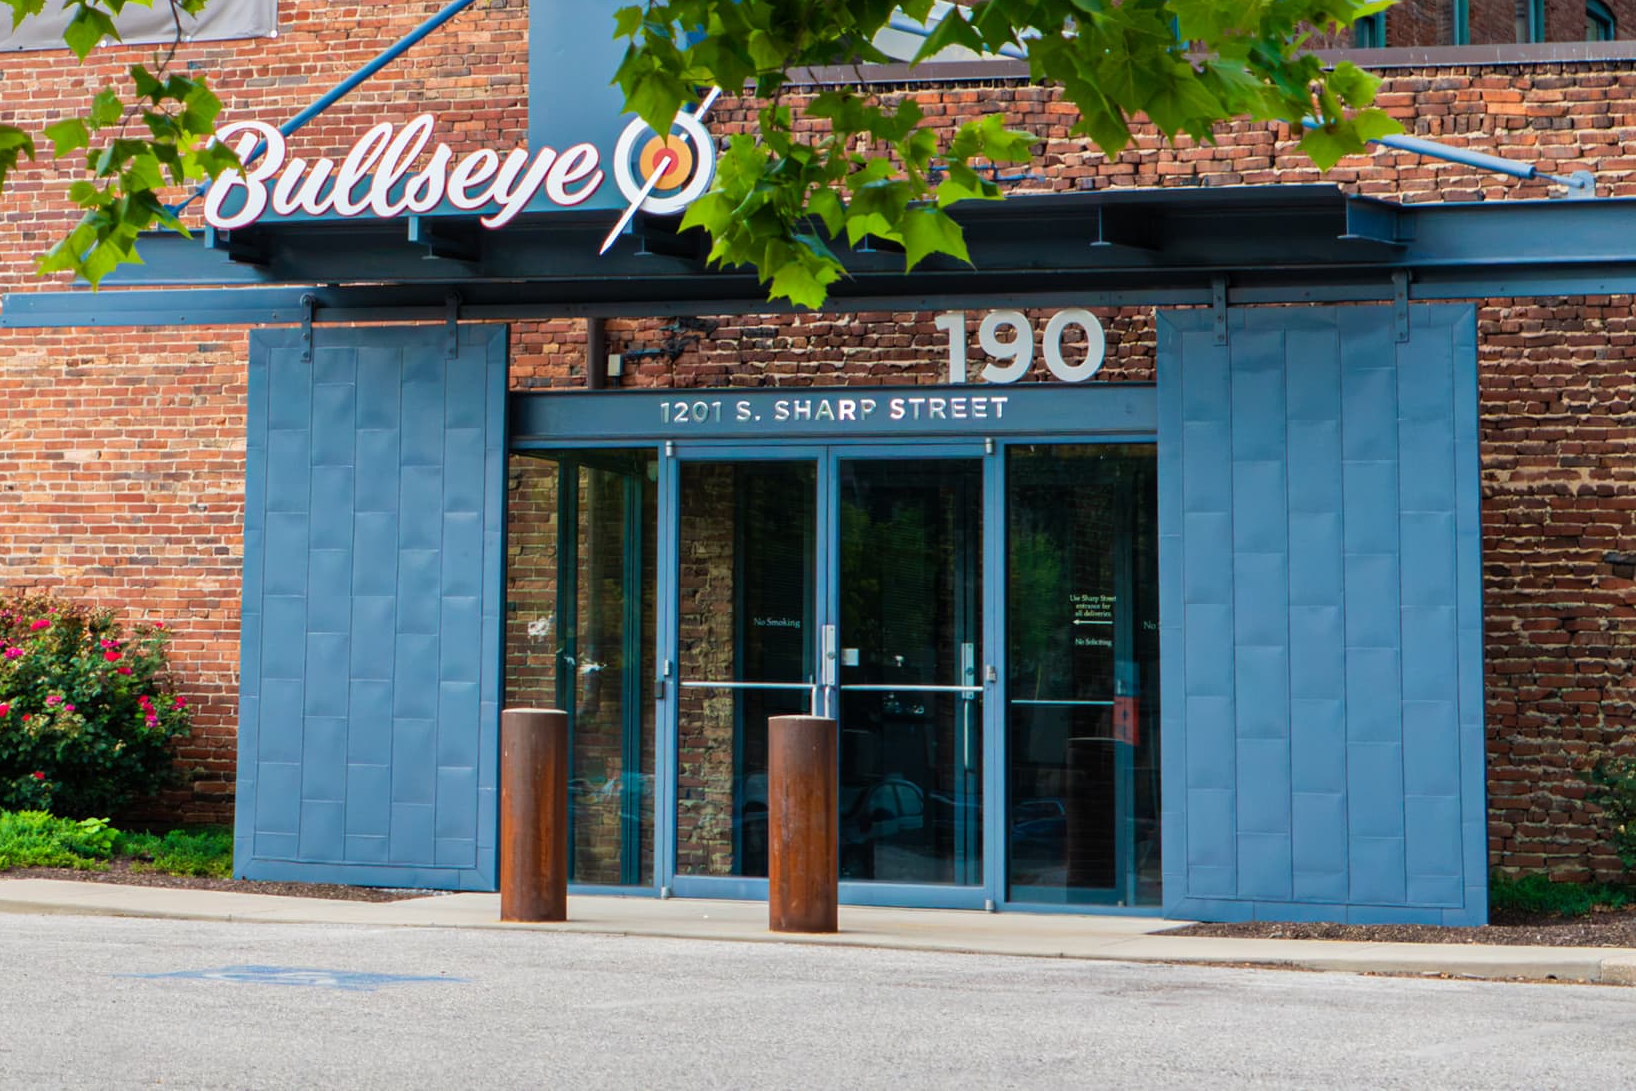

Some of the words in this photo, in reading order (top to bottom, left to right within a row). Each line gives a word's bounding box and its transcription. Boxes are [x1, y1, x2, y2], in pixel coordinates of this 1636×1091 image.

[204, 113, 605, 230] Bullseye
[935, 310, 1106, 385] 190
[660, 401, 723, 424] 1201
[736, 400, 762, 423] S.
[774, 399, 877, 422] SHARP
[889, 395, 1010, 420] STREET
[1082, 594, 1100, 604] Sharp
[753, 617, 766, 627] No
[766, 617, 801, 629] Smoking
